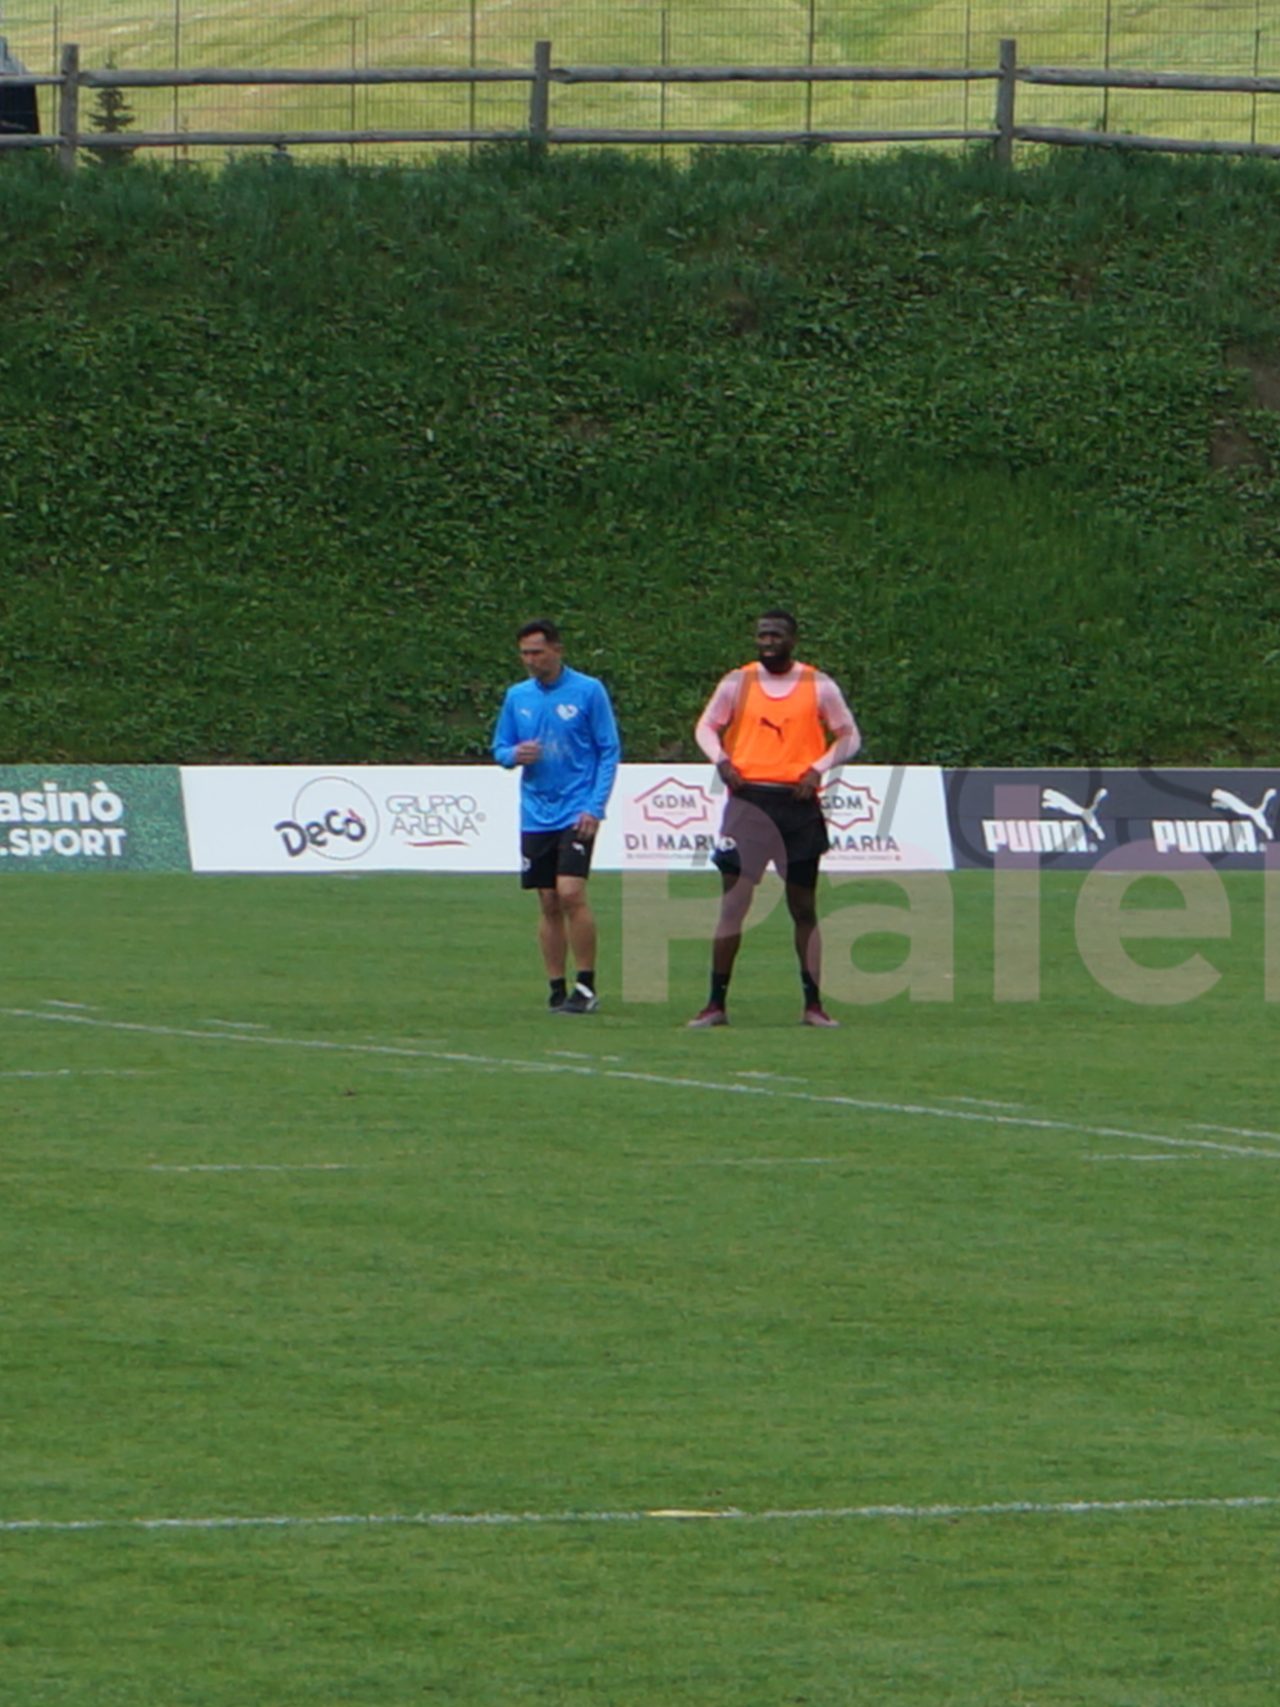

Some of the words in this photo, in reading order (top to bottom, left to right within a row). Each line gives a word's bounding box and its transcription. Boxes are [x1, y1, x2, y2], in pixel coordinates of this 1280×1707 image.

[386, 795, 477, 814] GRUPPO
[652, 794, 697, 809] GDM
[821, 795, 863, 810] GDM
[390, 815, 480, 836] ARENA
[625, 834, 648, 850] DI
[657, 834, 717, 851] MARI
[982, 820, 1089, 852] PUMA
[1152, 820, 1257, 852] PUMA
